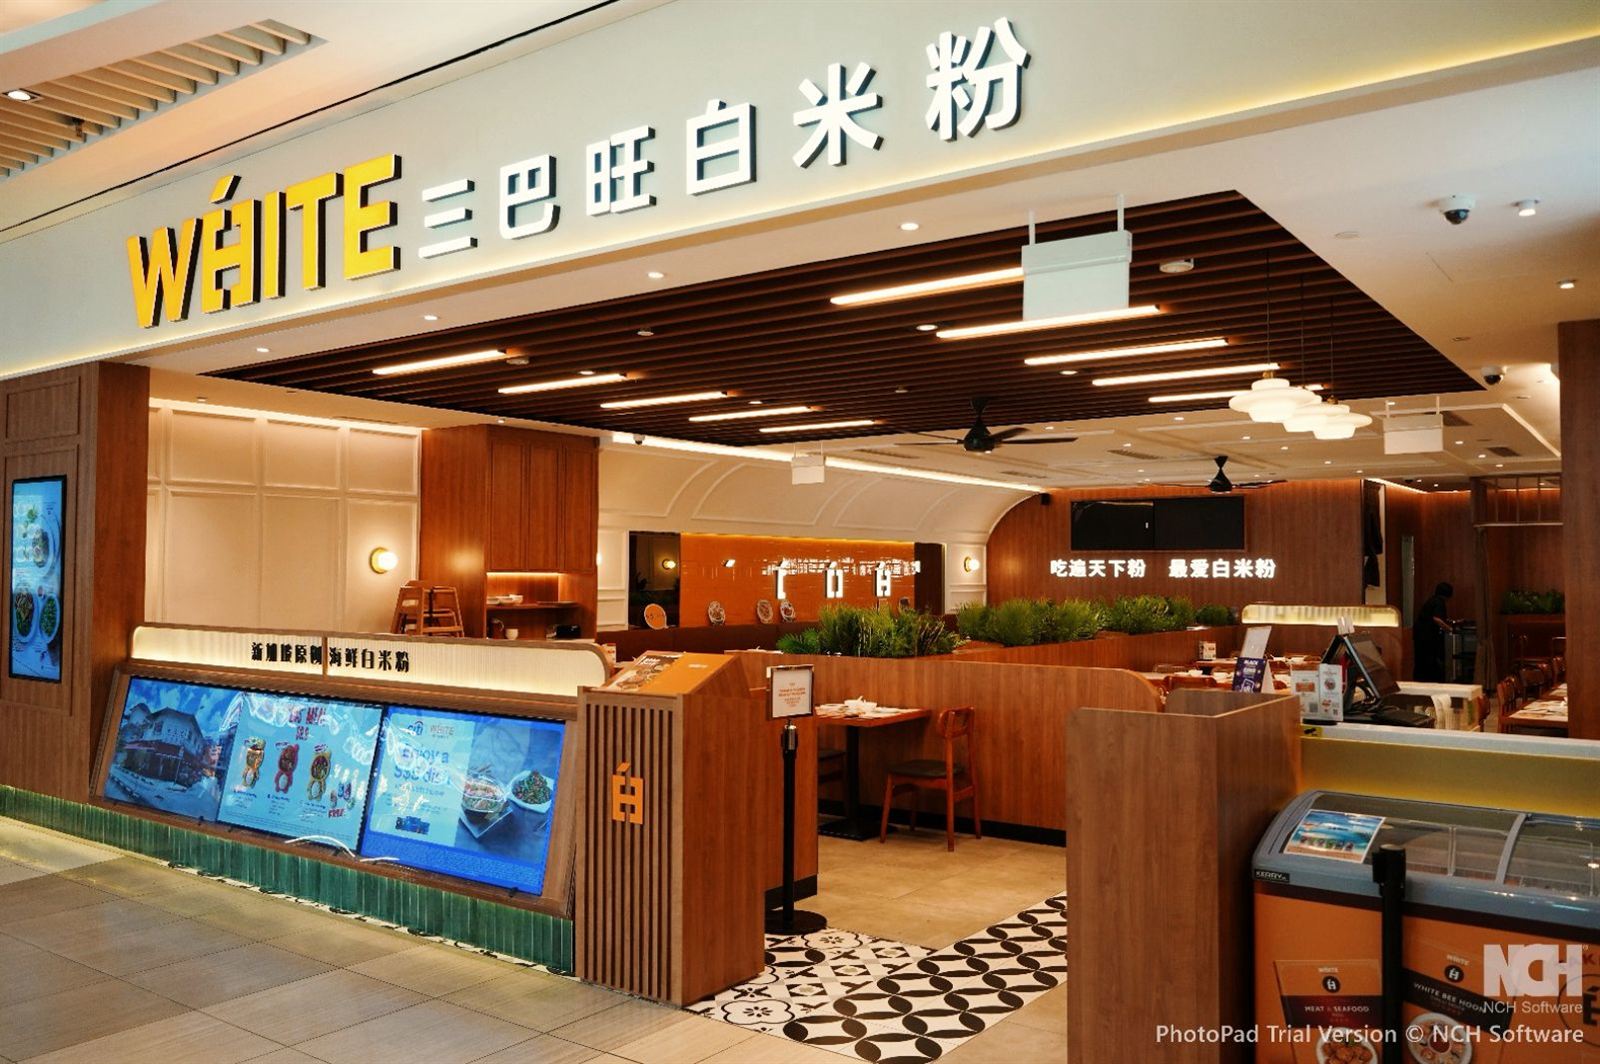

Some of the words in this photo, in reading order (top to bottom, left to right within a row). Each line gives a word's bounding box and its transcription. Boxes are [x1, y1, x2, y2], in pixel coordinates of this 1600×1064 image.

[418, 16, 1031, 259] 三巴旺白米粉
[1050, 558, 1147, 578] 吃遍天下粉
[1333, 1005, 1370, 1013] SEAFOOD
